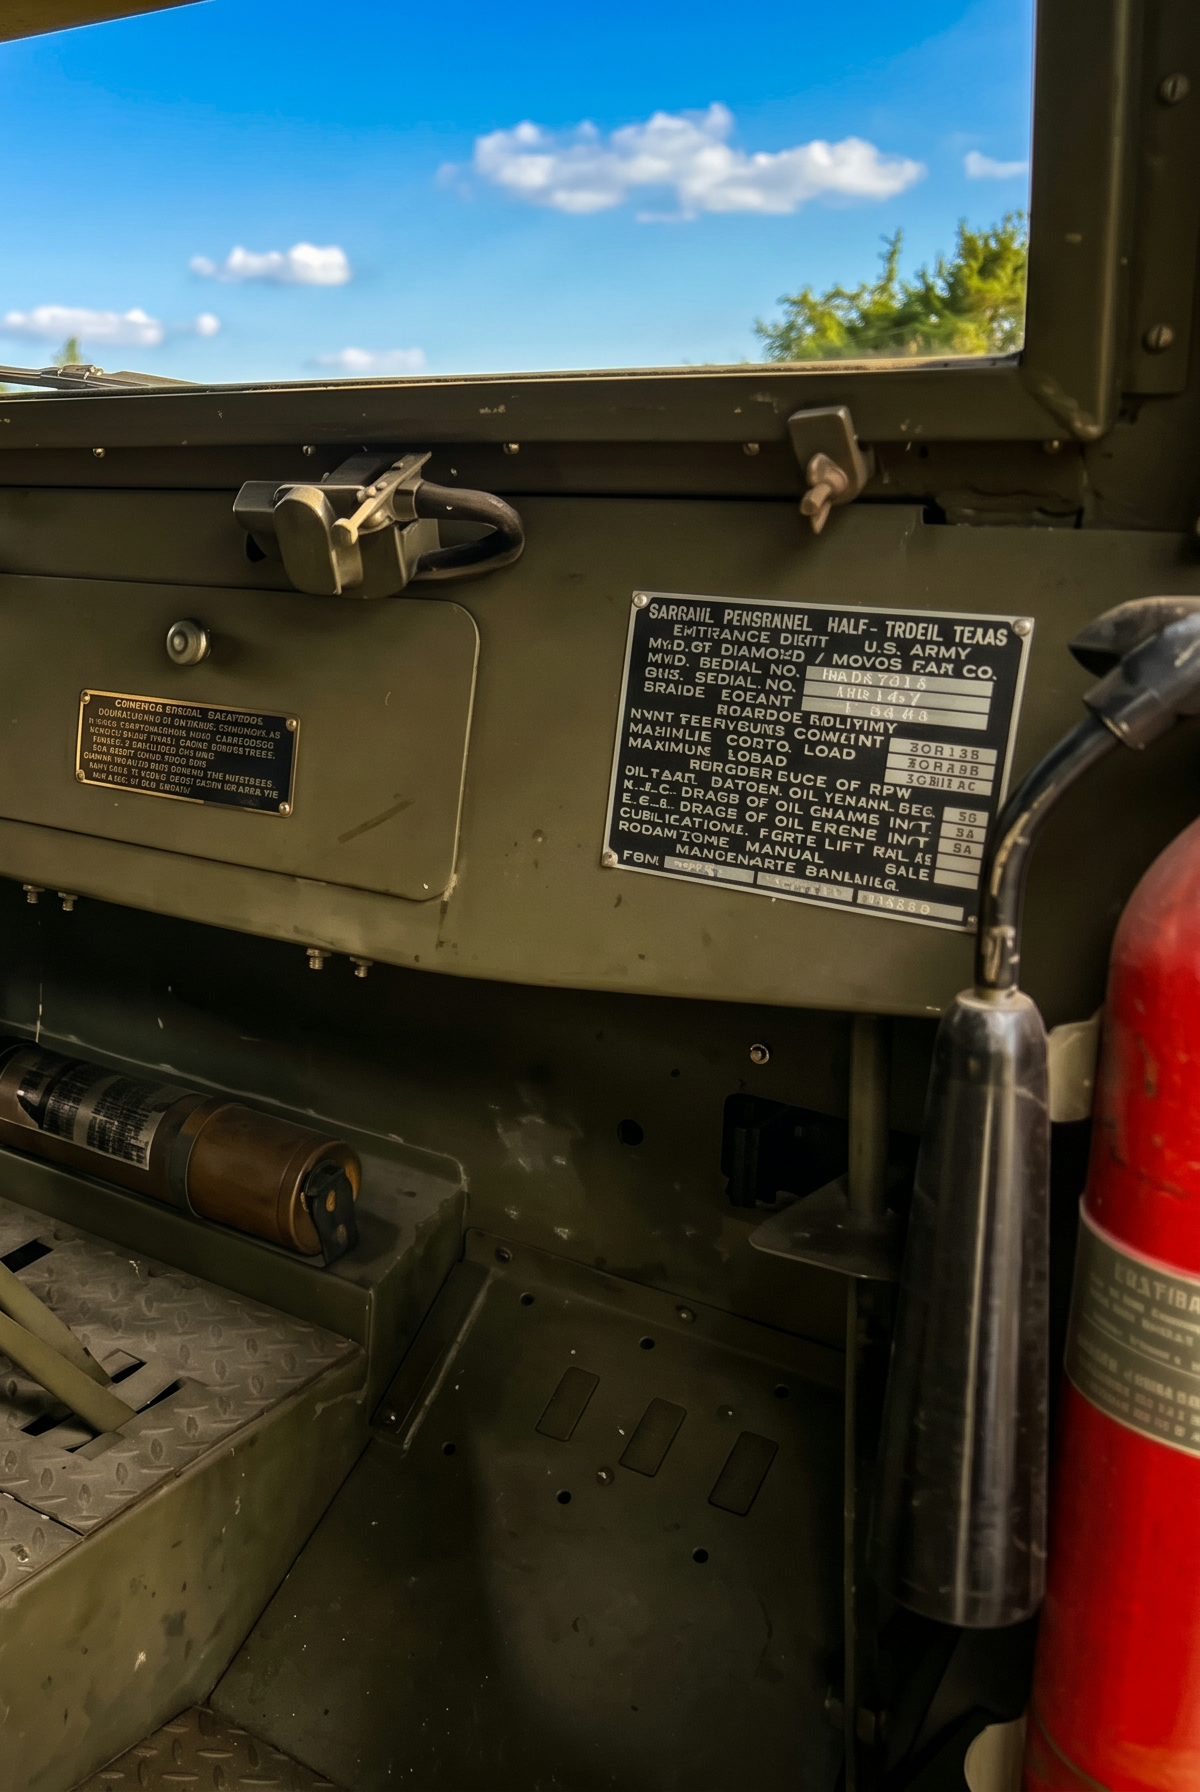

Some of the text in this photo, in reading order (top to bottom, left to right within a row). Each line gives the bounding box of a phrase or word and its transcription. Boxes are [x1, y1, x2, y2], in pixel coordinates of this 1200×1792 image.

[864, 640, 901, 656] U.S.
[909, 643, 973, 661] ARMY
[769, 663, 801, 679] NO.
[832, 652, 903, 671] MOVOS
[962, 664, 998, 681] CO.
[765, 678, 797, 693] NO.
[803, 743, 857, 761] LOAD
[788, 786, 819, 802] OIL
[835, 778, 862, 794] OF
[869, 782, 913, 800] RPW
[745, 795, 770, 809] OF
[774, 799, 805, 815] OIL
[744, 809, 770, 824] OF
[774, 814, 805, 831] OIL
[745, 840, 825, 864] MANUAL
[824, 837, 866, 855] LIFT
